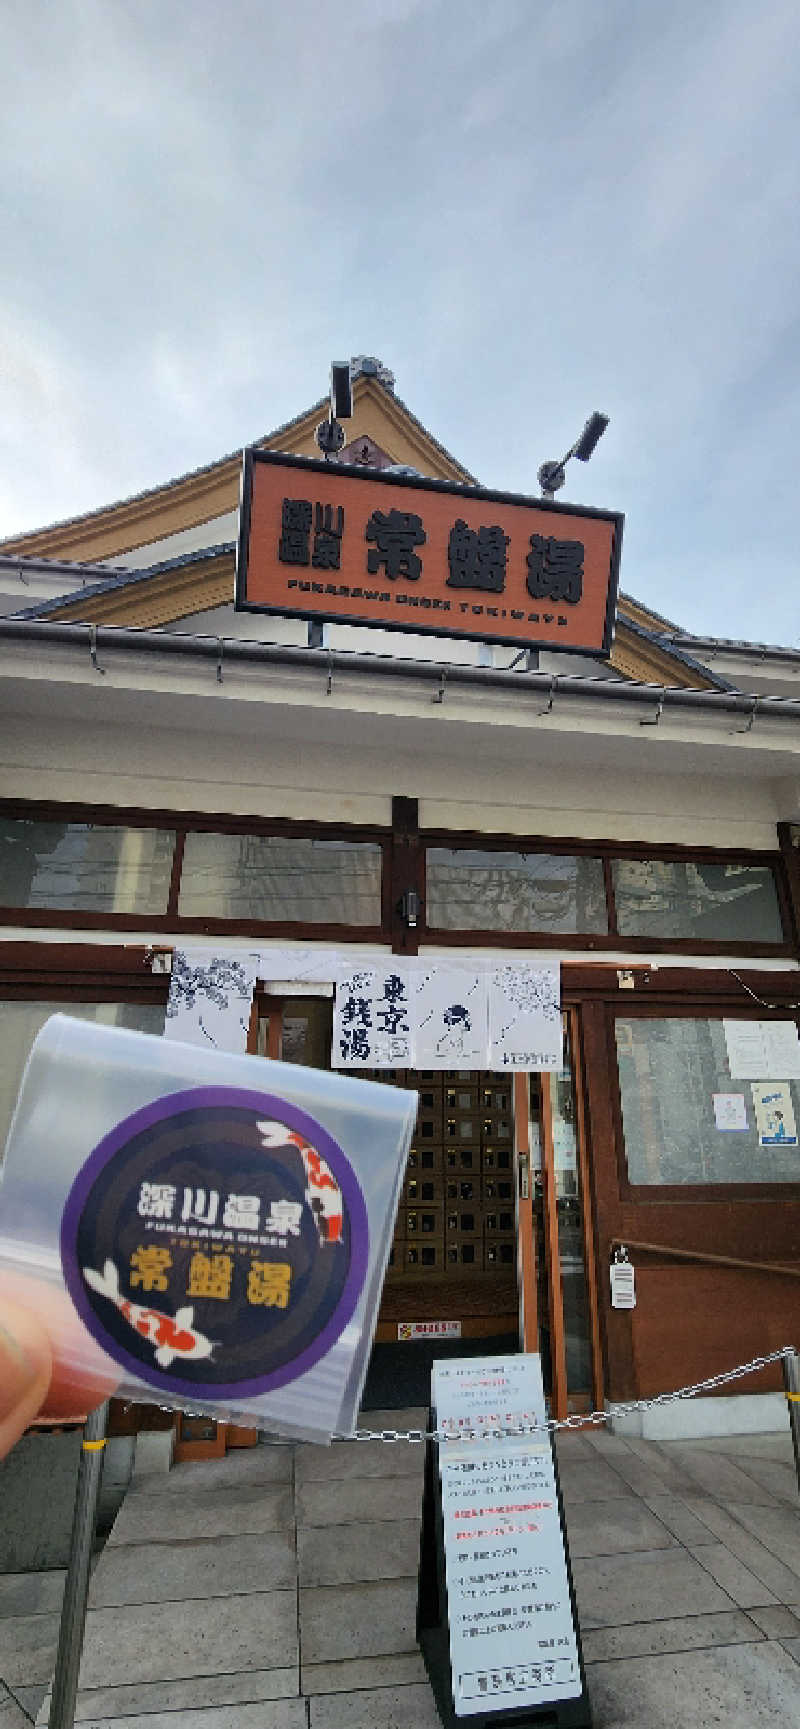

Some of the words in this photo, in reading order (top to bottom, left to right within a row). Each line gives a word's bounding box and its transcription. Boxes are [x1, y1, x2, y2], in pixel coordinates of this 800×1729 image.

[281, 498, 344, 538] 深川
[366, 508, 585, 604] 常盤湯
[339, 997, 372, 1061] 銭湯
[376, 974, 410, 1035] 東京
[137, 1182, 304, 1236] 深川温泉
[144, 1221, 234, 1241] FUKAGAWA
[237, 1234, 288, 1249] ONSEN
[170, 1238, 261, 1257] TOKIWAYU
[129, 1244, 293, 1309] 常盤湯
